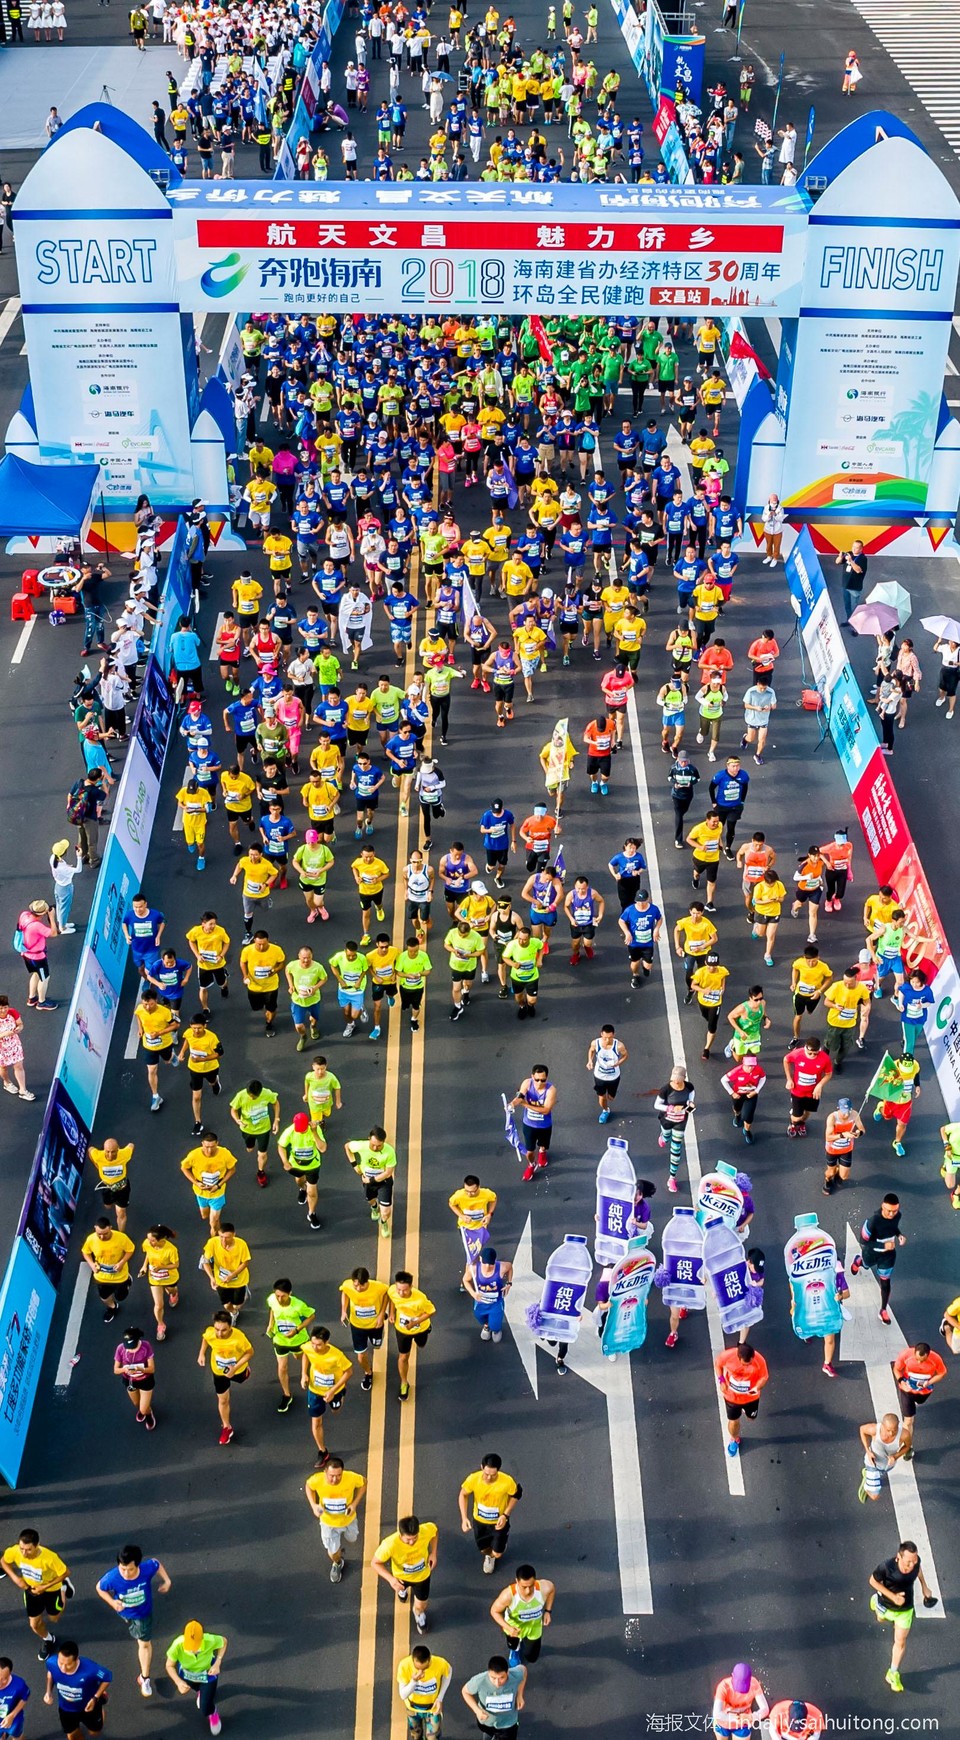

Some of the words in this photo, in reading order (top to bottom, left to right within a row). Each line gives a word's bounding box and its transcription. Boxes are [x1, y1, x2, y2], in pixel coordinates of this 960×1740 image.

[267, 223, 447, 247] 航天文昌
[536, 225, 716, 250] 魅力侨乡
[36, 239, 157, 284] START
[257, 257, 383, 288] 奔跑海南
[513, 259, 781, 282] 海南建省办经济特区30周年
[820, 246, 944, 291] FINISH
[401, 258, 505, 299] 2018
[284, 293, 360, 304] 跑向更好的自己
[513, 284, 644, 305] 环岛全民健跑
[658, 289, 702, 304] 文昌站
[943, 1035, 956, 1069] CHINA
[607, 1202, 624, 1234] 纯悦
[702, 1193, 737, 1217] 水动乐
[676, 1259, 693, 1282] 纯悦
[792, 1256, 833, 1272] 水动乐
[614, 1274, 650, 1292] 水动乐
[723, 1270, 744, 1299] 纯悦
[554, 1286, 574, 1312] 纯悦
